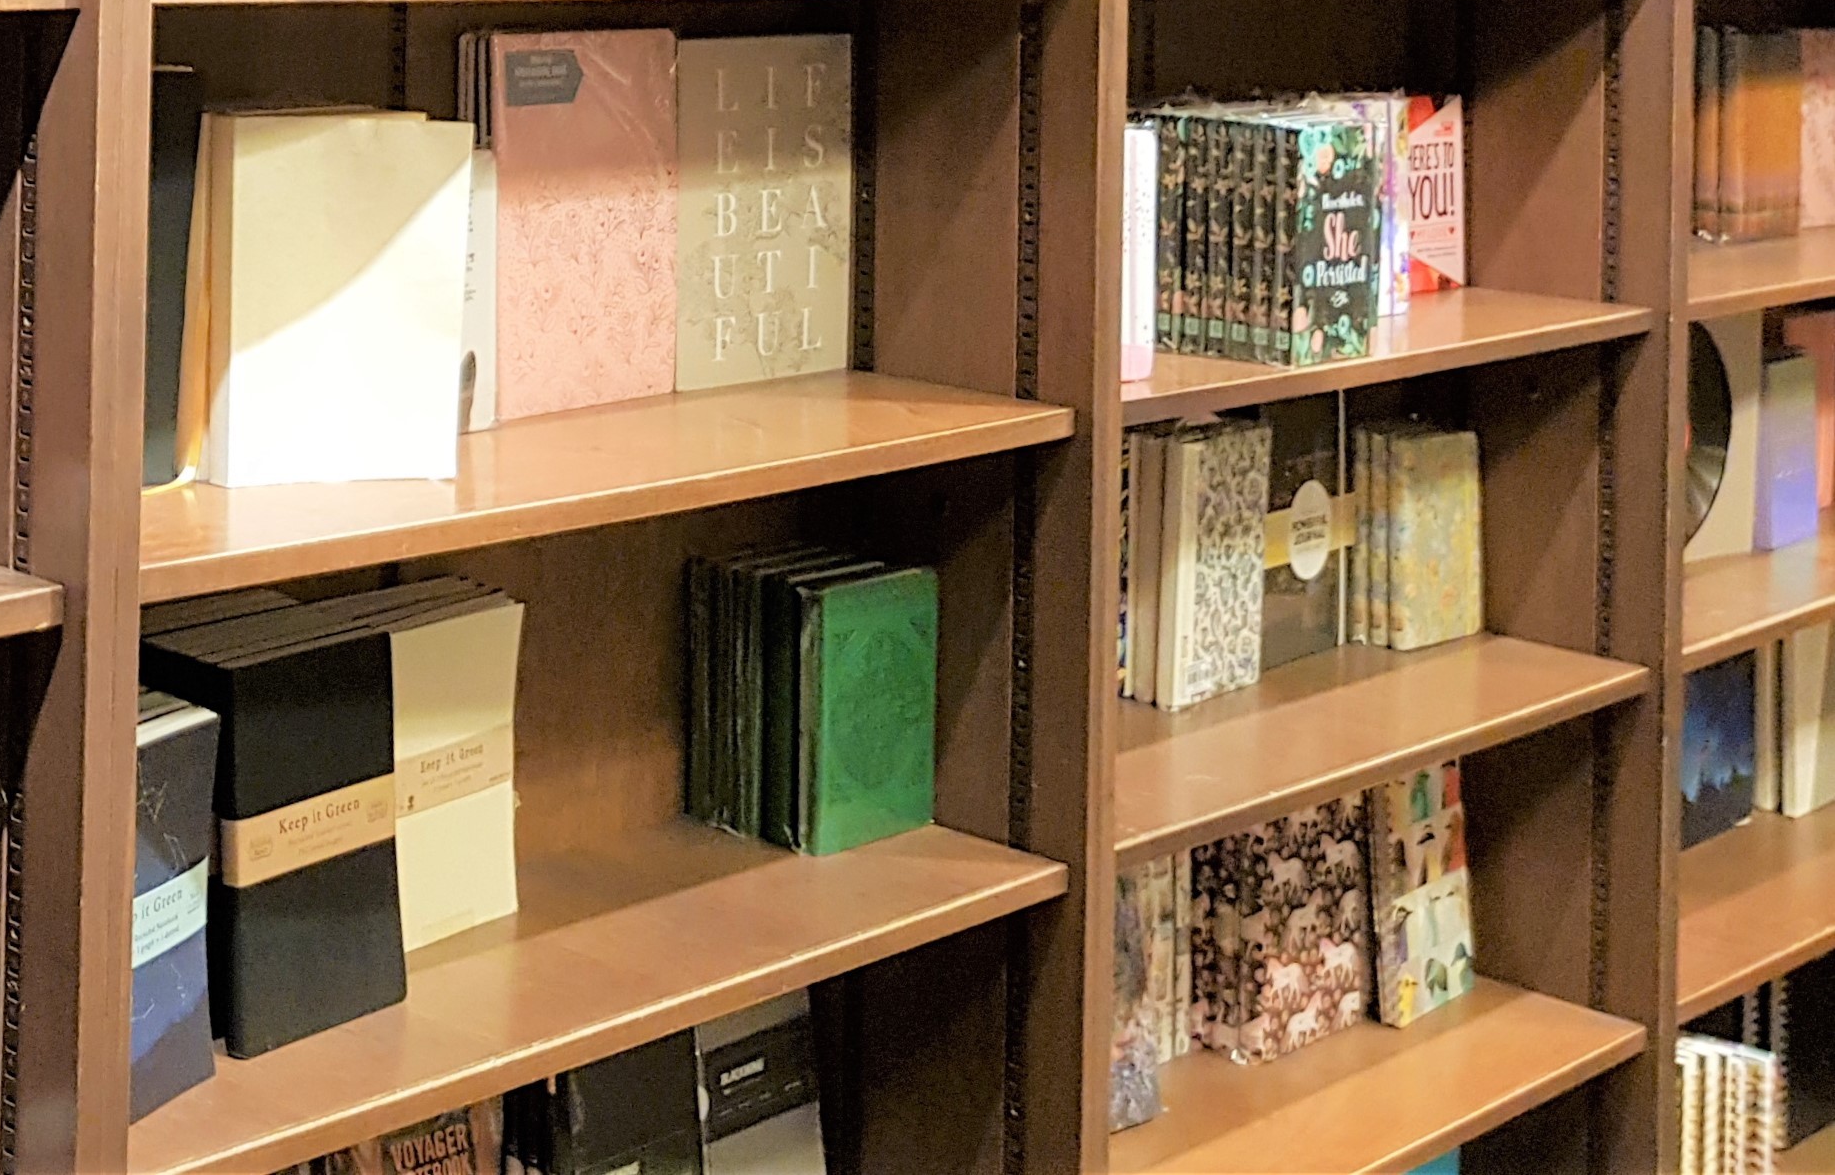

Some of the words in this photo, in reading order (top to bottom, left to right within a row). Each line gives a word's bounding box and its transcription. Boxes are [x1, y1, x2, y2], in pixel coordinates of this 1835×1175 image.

[1408, 171, 1455, 221] YOU!
[1323, 211, 1361, 261] She
[1316, 255, 1368, 287] Persisted
[278, 816, 308, 835] Keep
[326, 799, 360, 819] Green
[153, 890, 183, 913] Green
[390, 1124, 469, 1171] VOYAGER
